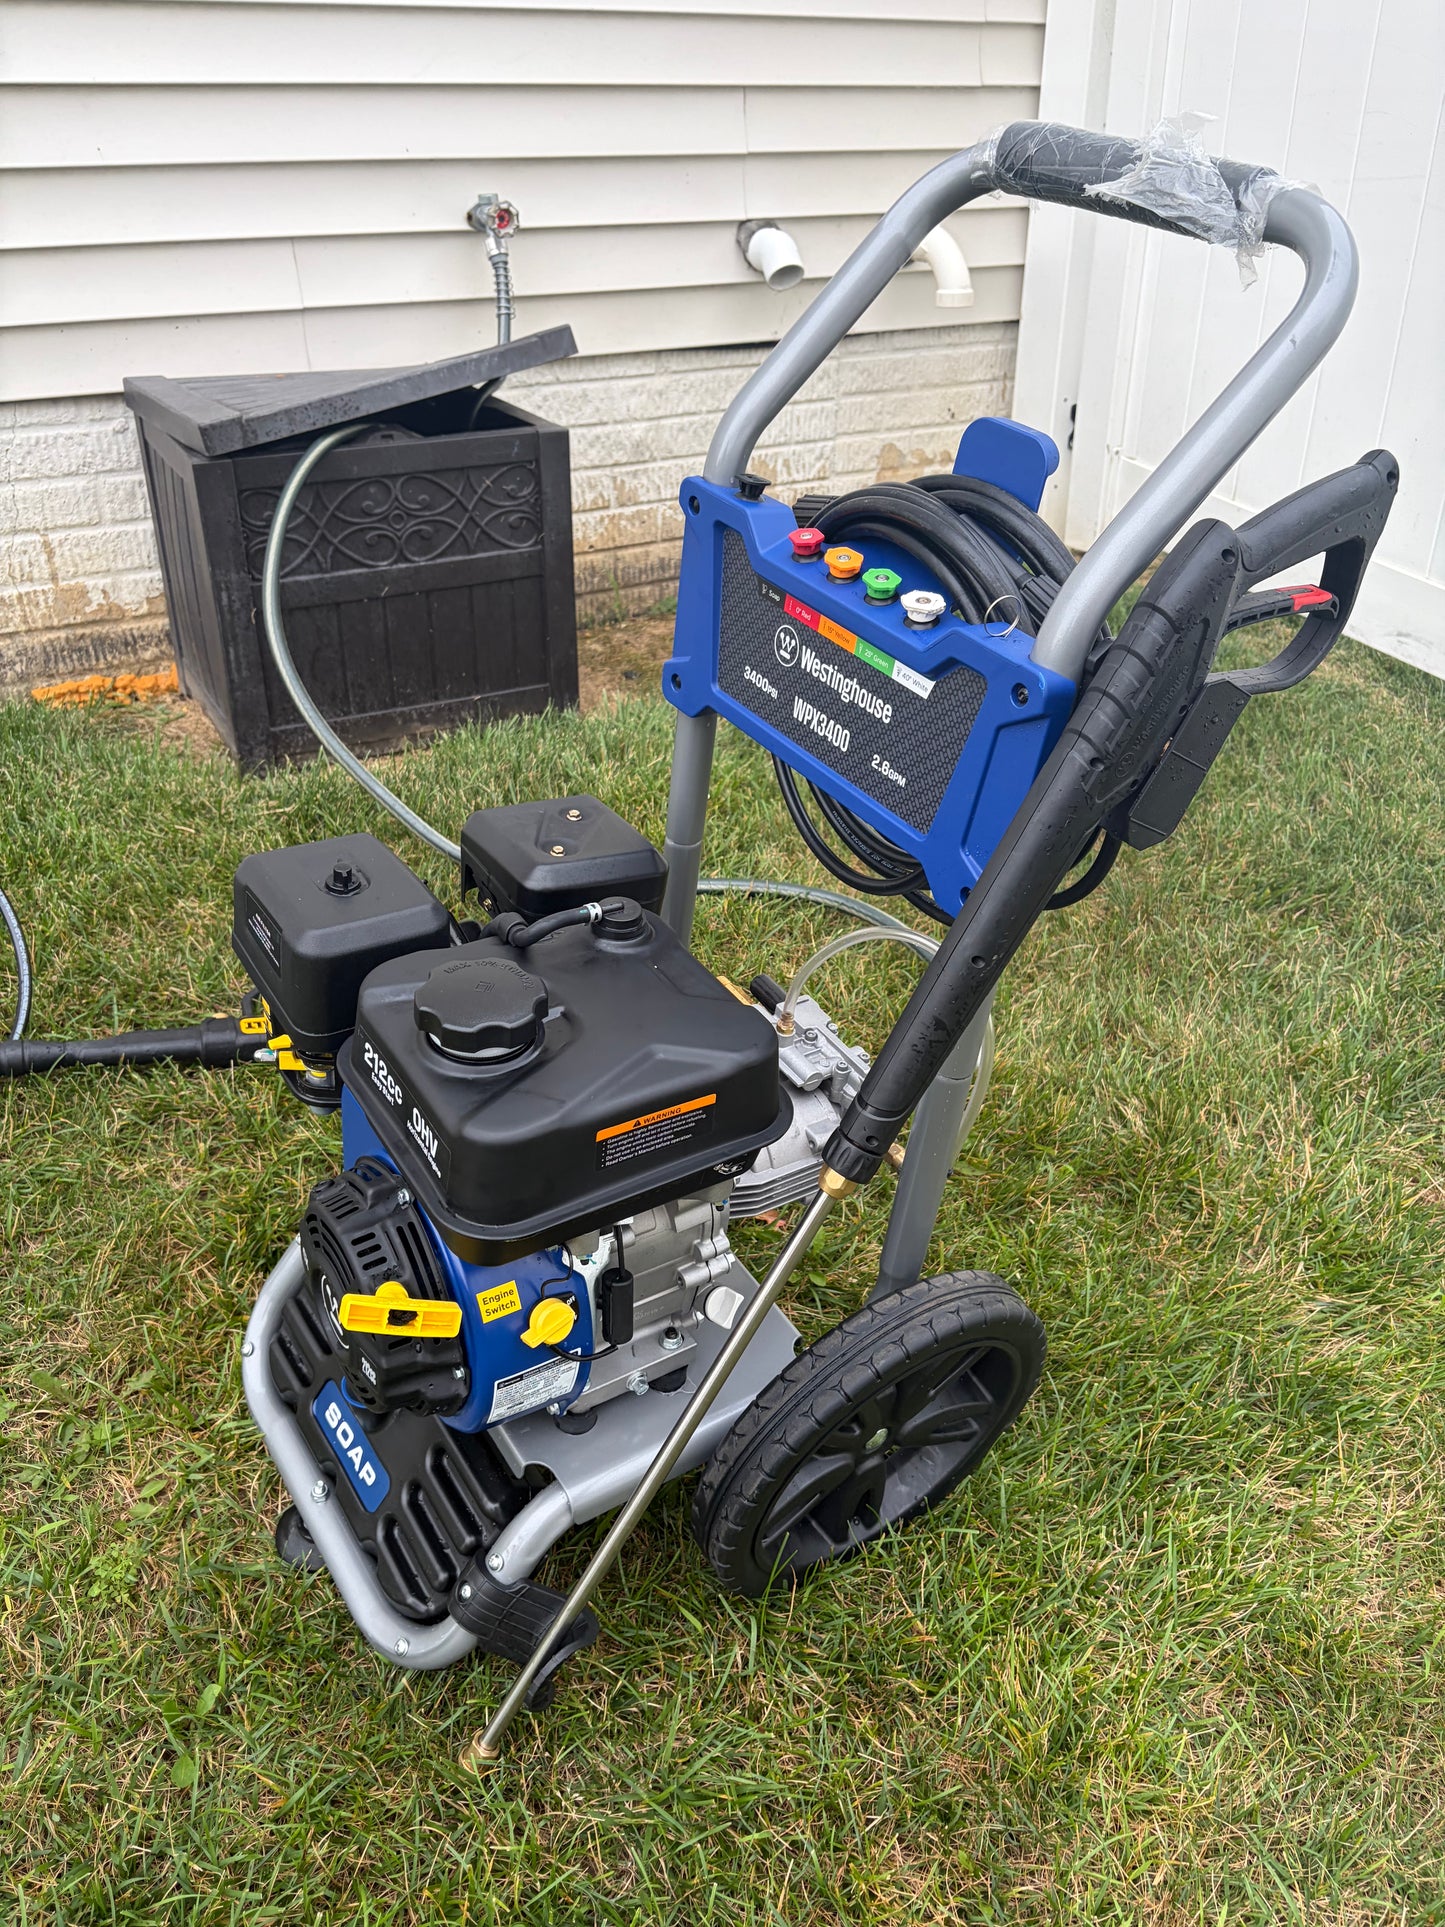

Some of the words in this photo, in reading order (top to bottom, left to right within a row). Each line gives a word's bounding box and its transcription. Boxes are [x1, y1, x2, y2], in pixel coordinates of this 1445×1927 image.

[769, 589, 780, 601] Soap
[802, 610, 812, 621] Red
[835, 629, 850, 644] Yellow
[874, 655, 889, 669] Green
[801, 645, 893, 724] Westinghouse
[912, 678, 928, 693] White
[793, 695, 850, 752] WPX3400
[364, 1042, 403, 1105] 212cc
[643, 1107, 682, 1125] WARNING
[412, 1107, 439, 1159] OHV
[482, 1287, 515, 1305] Engine
[566, 1295, 576, 1306] OFF
[485, 1299, 516, 1317] Switch
[324, 1401, 376, 1487] SOAP
